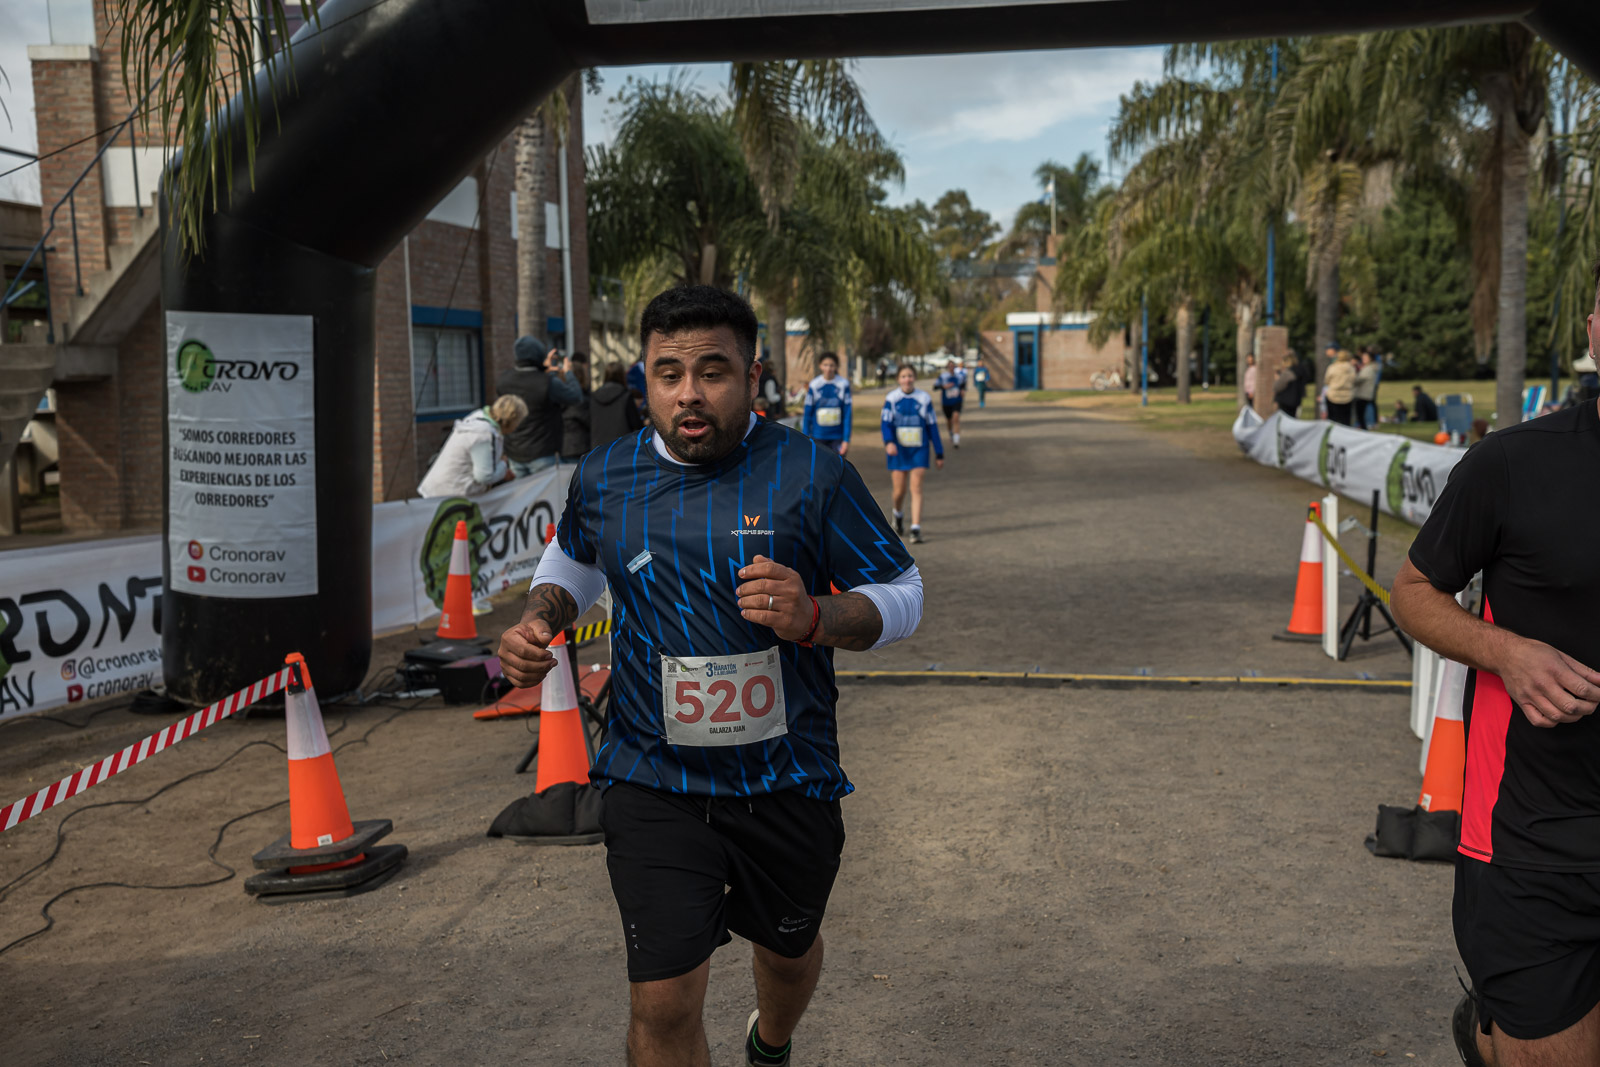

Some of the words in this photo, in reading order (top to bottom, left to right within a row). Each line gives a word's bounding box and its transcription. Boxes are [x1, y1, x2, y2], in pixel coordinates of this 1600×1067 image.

[202, 358, 299, 381] CRONO
[201, 381, 232, 393] RAV
[217, 431, 296, 445] CORREDORES
[173, 447, 222, 465] BUSCANDO
[224, 452, 282, 466] MEJORAR
[285, 452, 307, 466] LAS
[180, 469, 252, 486] EXPERIENCIAS
[255, 474, 271, 487] DE
[274, 473, 296, 486] LOS
[195, 492, 275, 508] CORREDORES”
[730, 529, 757, 537] XTREME
[209, 545, 286, 562] Cronorav
[209, 567, 286, 584] Cronorav
[705, 661, 714, 677] 3
[87, 672, 154, 699] cronorav
[674, 675, 776, 724] 520
[709, 726, 732, 734] GALARZA
[732, 724, 746, 733] JUAN
